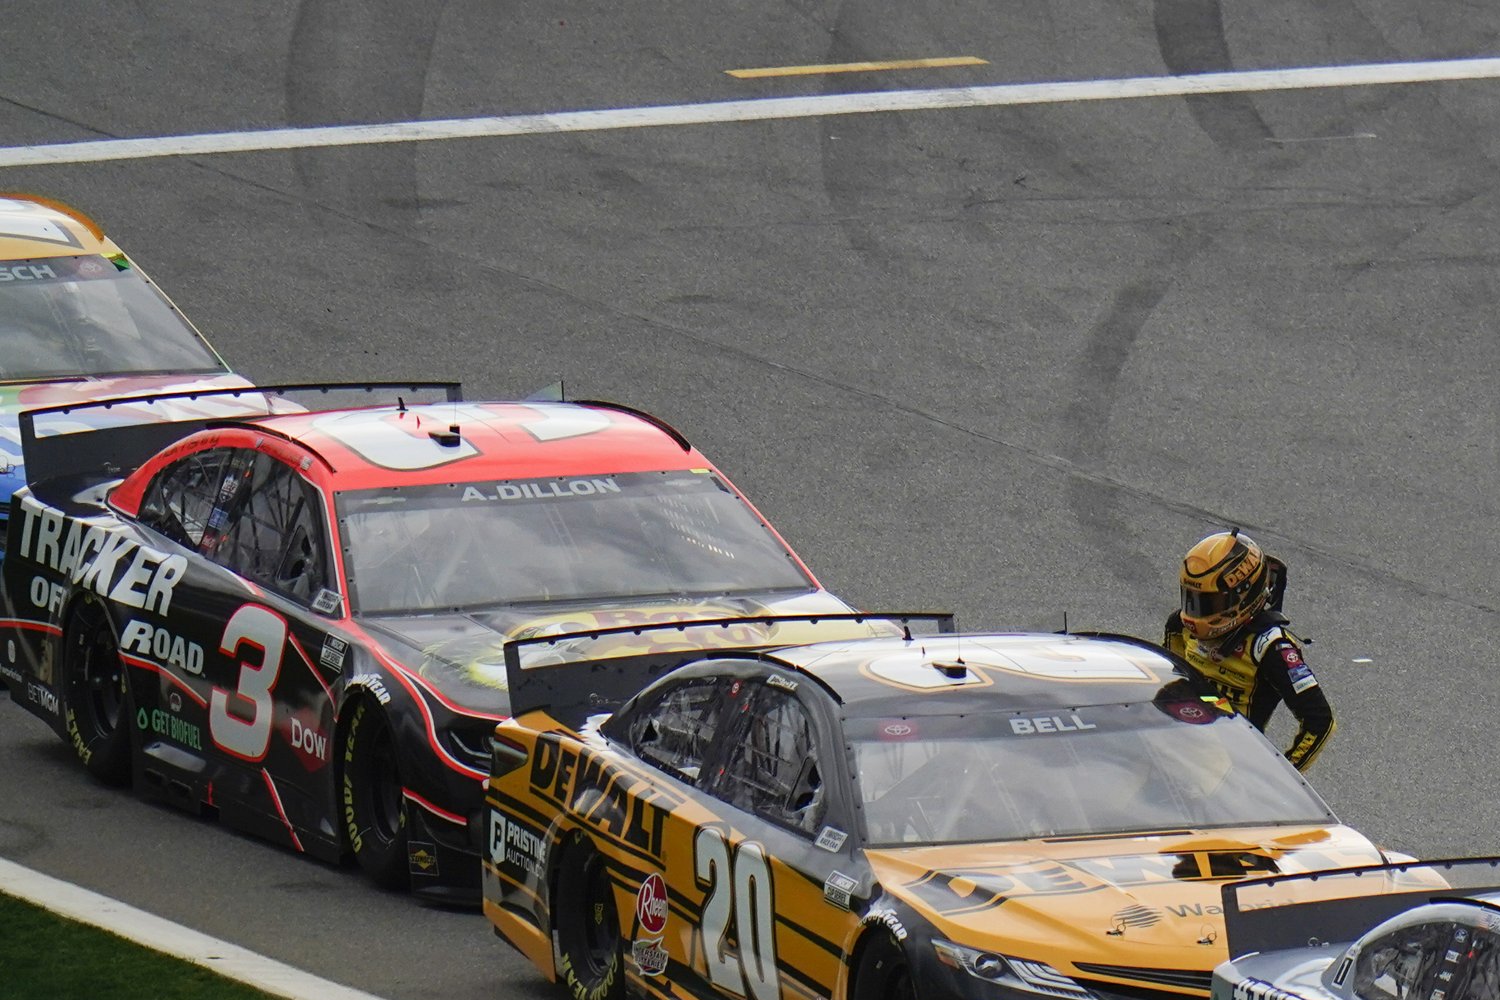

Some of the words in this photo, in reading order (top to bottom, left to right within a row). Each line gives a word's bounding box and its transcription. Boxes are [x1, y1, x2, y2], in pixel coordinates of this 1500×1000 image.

[461, 477, 623, 502] A.DILLON
[19, 502, 188, 617] TRACKER
[120, 619, 205, 677] ROAD
[209, 602, 288, 763] 3
[151, 708, 168, 735] GET
[170, 714, 202, 751] BIOFUEL
[290, 717, 327, 761] DOW
[1009, 714, 1097, 736] BELL
[530, 733, 677, 858] DEWALT
[640, 872, 668, 925] Rheem
